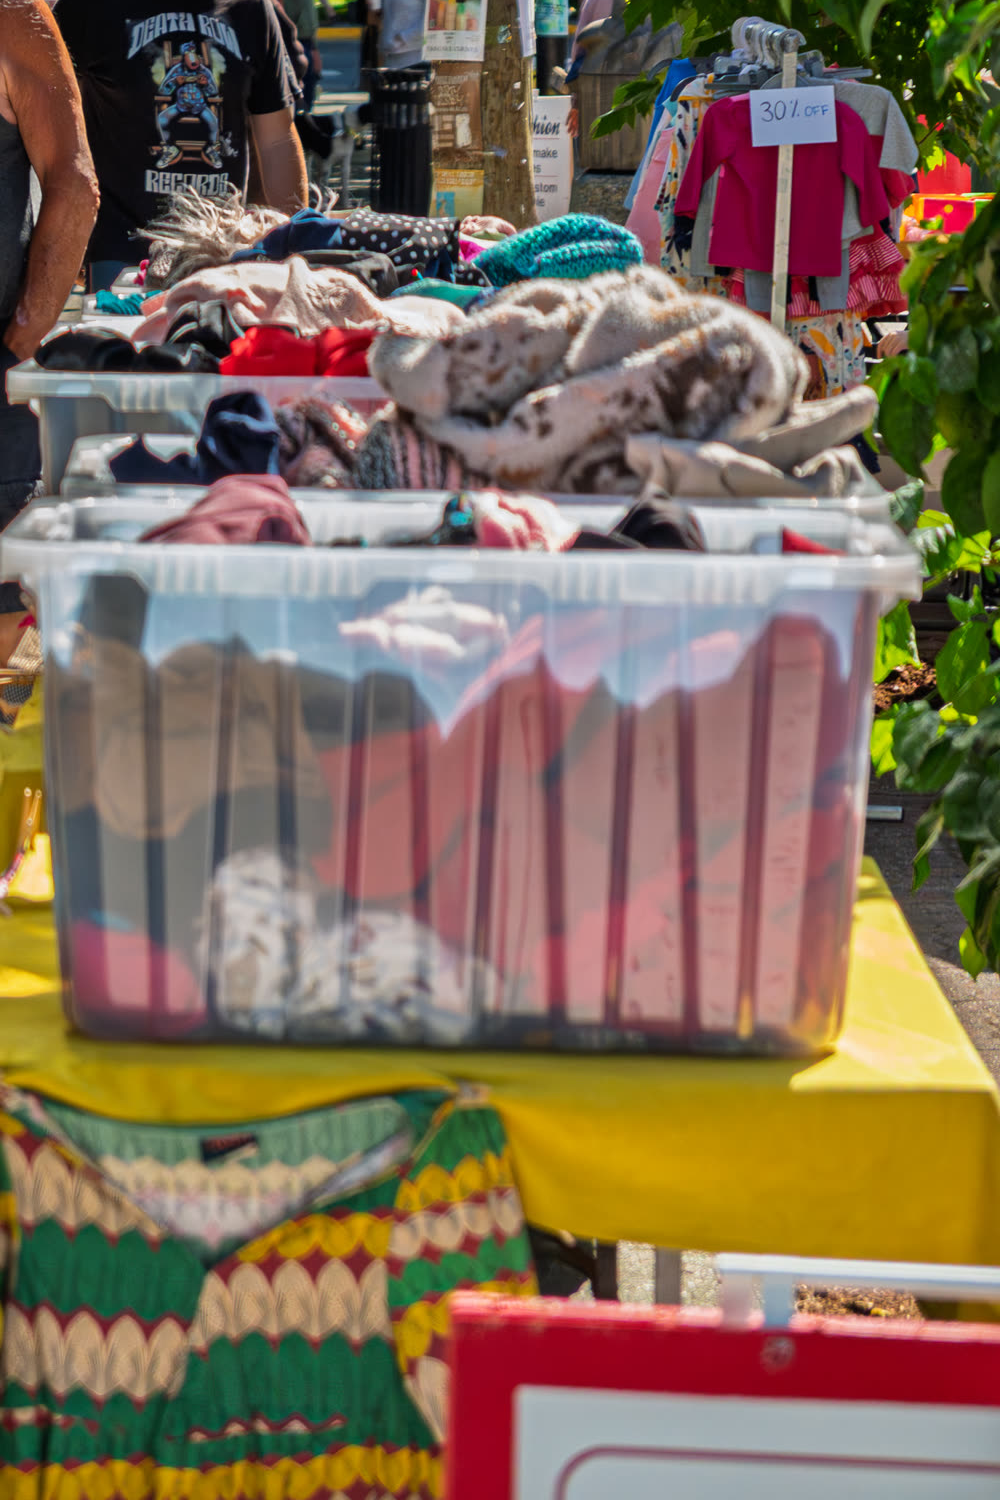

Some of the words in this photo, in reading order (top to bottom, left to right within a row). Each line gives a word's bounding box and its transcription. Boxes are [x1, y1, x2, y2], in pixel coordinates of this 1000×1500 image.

[126, 11, 197, 61] DEATH
[197, 13, 243, 61] ROW
[759, 98, 800, 123] 30%
[804, 104, 829, 117] OFF
[144, 168, 230, 196] RECORDS
